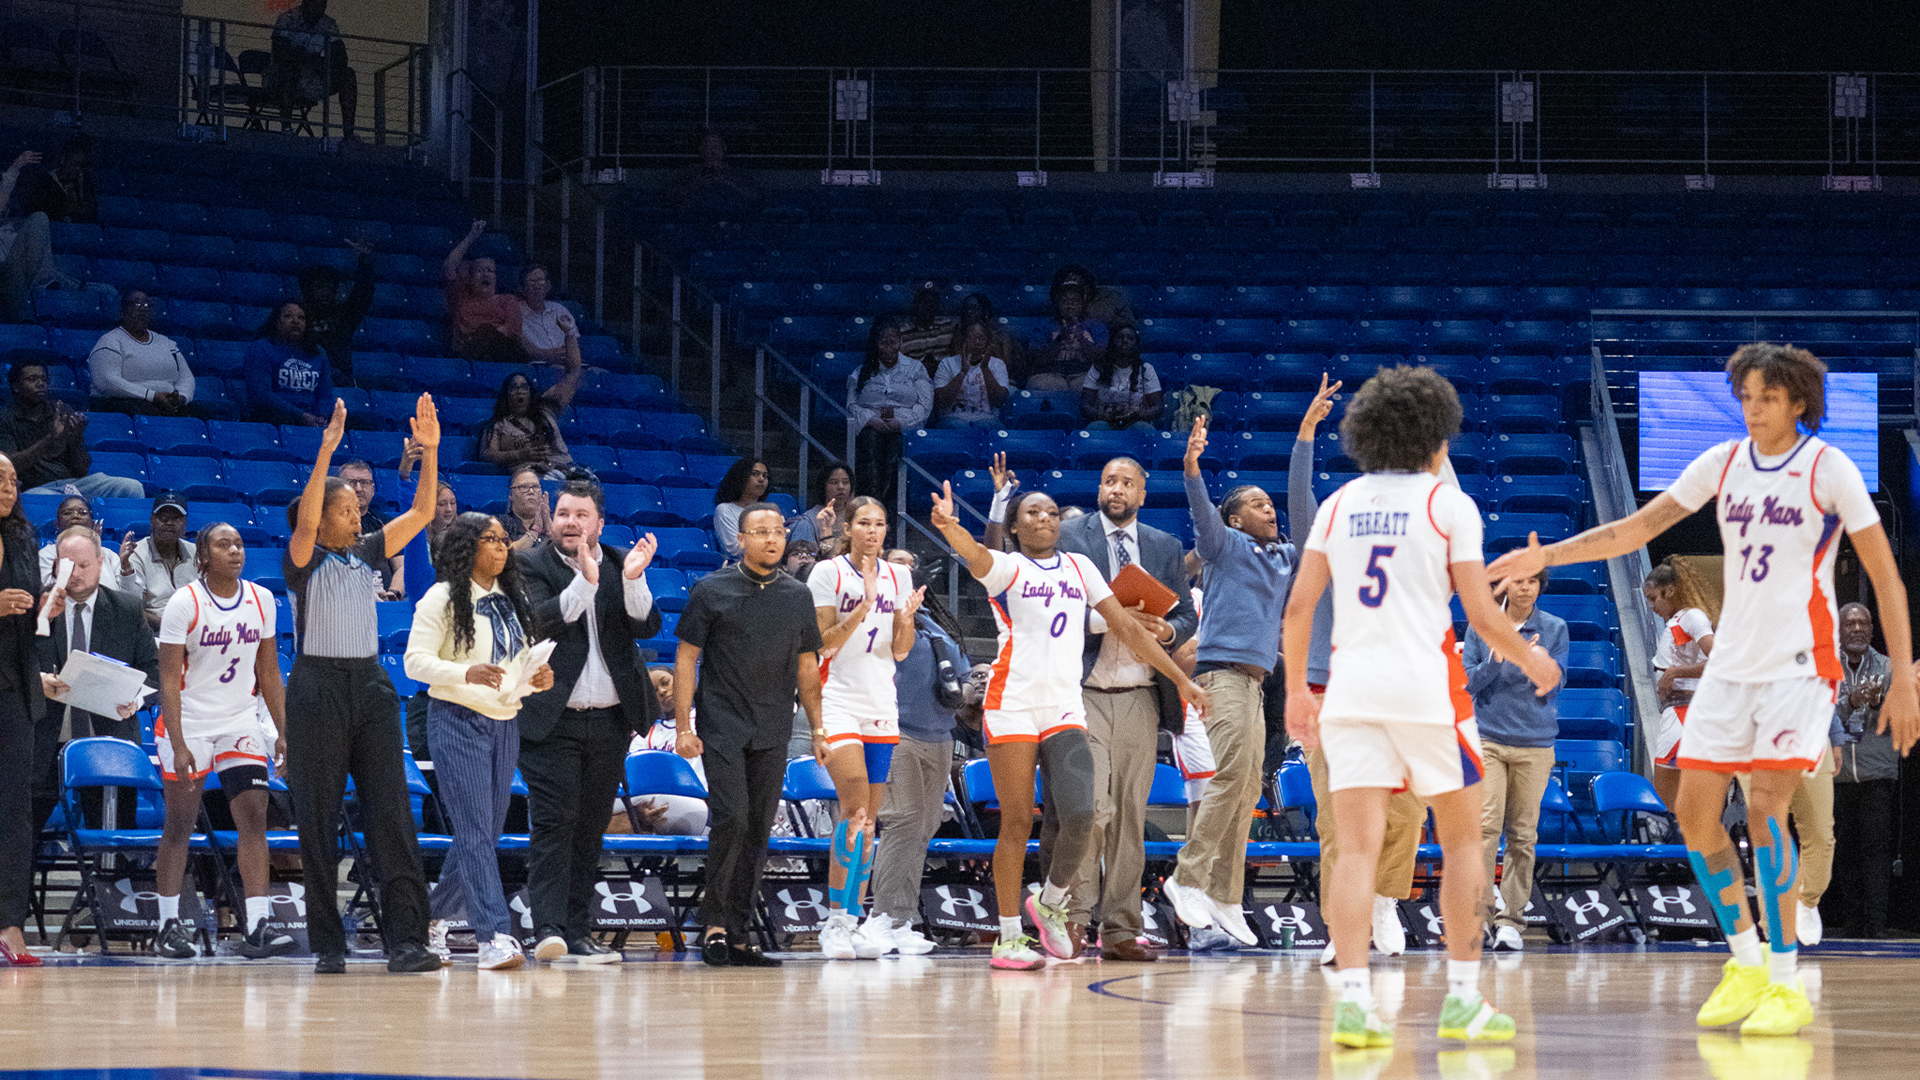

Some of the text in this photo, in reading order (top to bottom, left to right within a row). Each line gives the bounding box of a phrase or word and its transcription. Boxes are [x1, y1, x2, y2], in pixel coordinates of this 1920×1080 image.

[1349, 511, 1409, 537] THREATT
[1741, 544, 1774, 582] 13
[1358, 545, 1397, 608] 5
[840, 592, 865, 617] Lad
[1022, 580, 1055, 608] Lady
[1050, 611, 1067, 638] 0
[200, 624, 232, 655] Lady
[866, 626, 879, 653] 1
[219, 657, 240, 683] 3
[936, 917, 965, 927] UNDER
[1577, 915, 1625, 940] UNDER ARMOUR
[1649, 915, 1709, 925] UNDER ARMOUR
